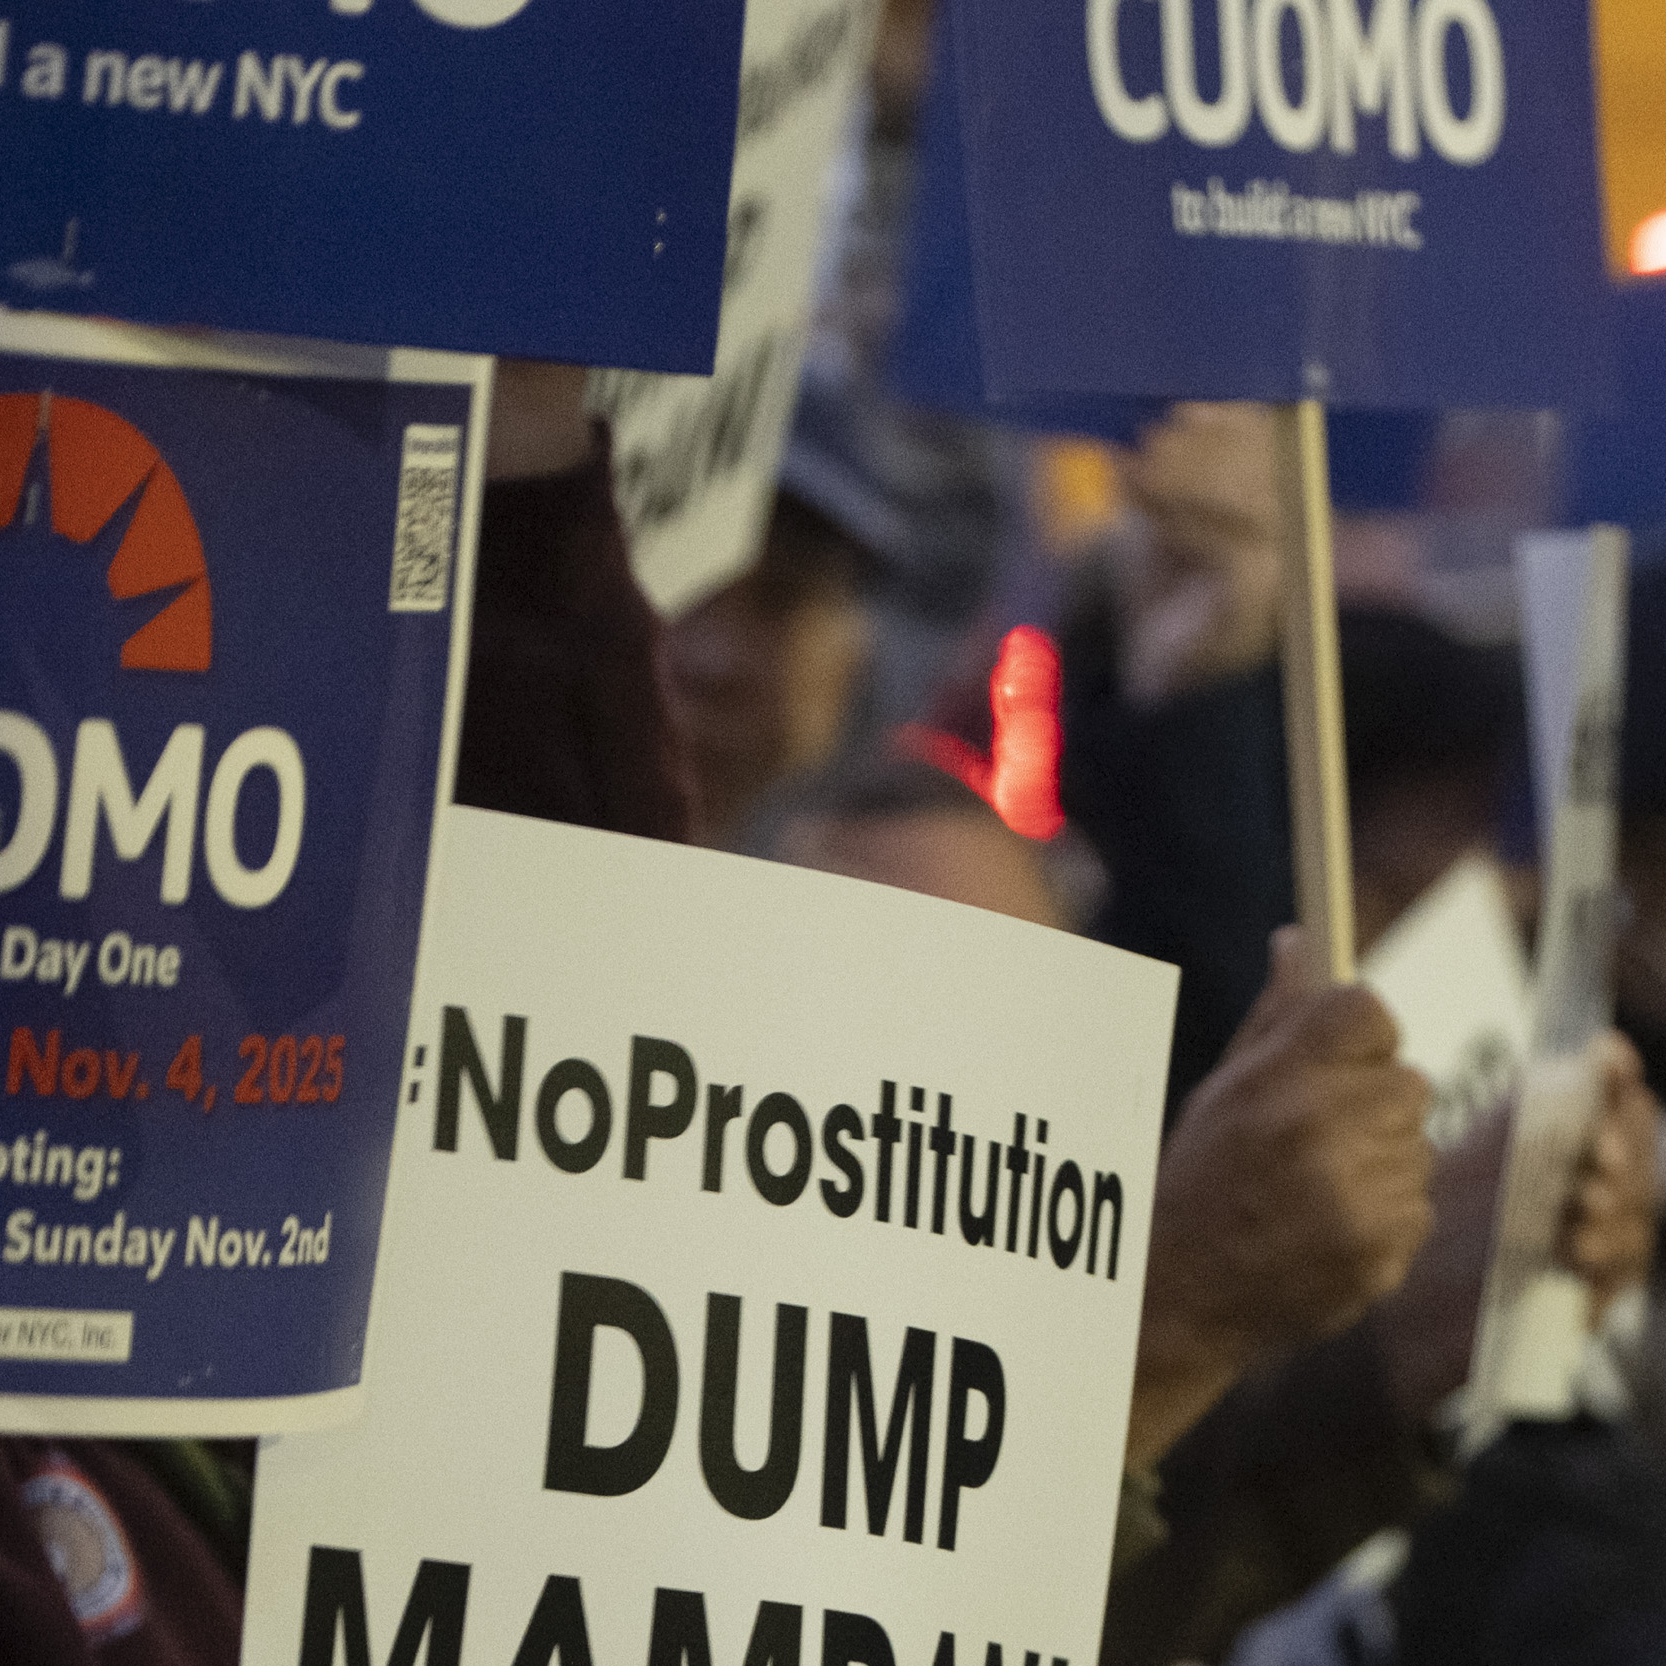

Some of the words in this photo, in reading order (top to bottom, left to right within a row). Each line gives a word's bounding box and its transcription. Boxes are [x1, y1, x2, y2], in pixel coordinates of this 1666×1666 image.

[22, 42, 67, 99] a
[83, 49, 222, 114] new
[233, 50, 365, 130] NYC
[0, 925, 91, 996] Day
[96, 930, 183, 989] One
[6, 1024, 149, 1102] Nov.
[166, 1032, 217, 1113] 4,
[234, 1032, 346, 1106] 2025
[1, 1207, 176, 1281] Sunday
[184, 1214, 272, 1268] Nov.
[278, 1209, 333, 1269] 2nd
[542, 1270, 1008, 1552] DUMP
